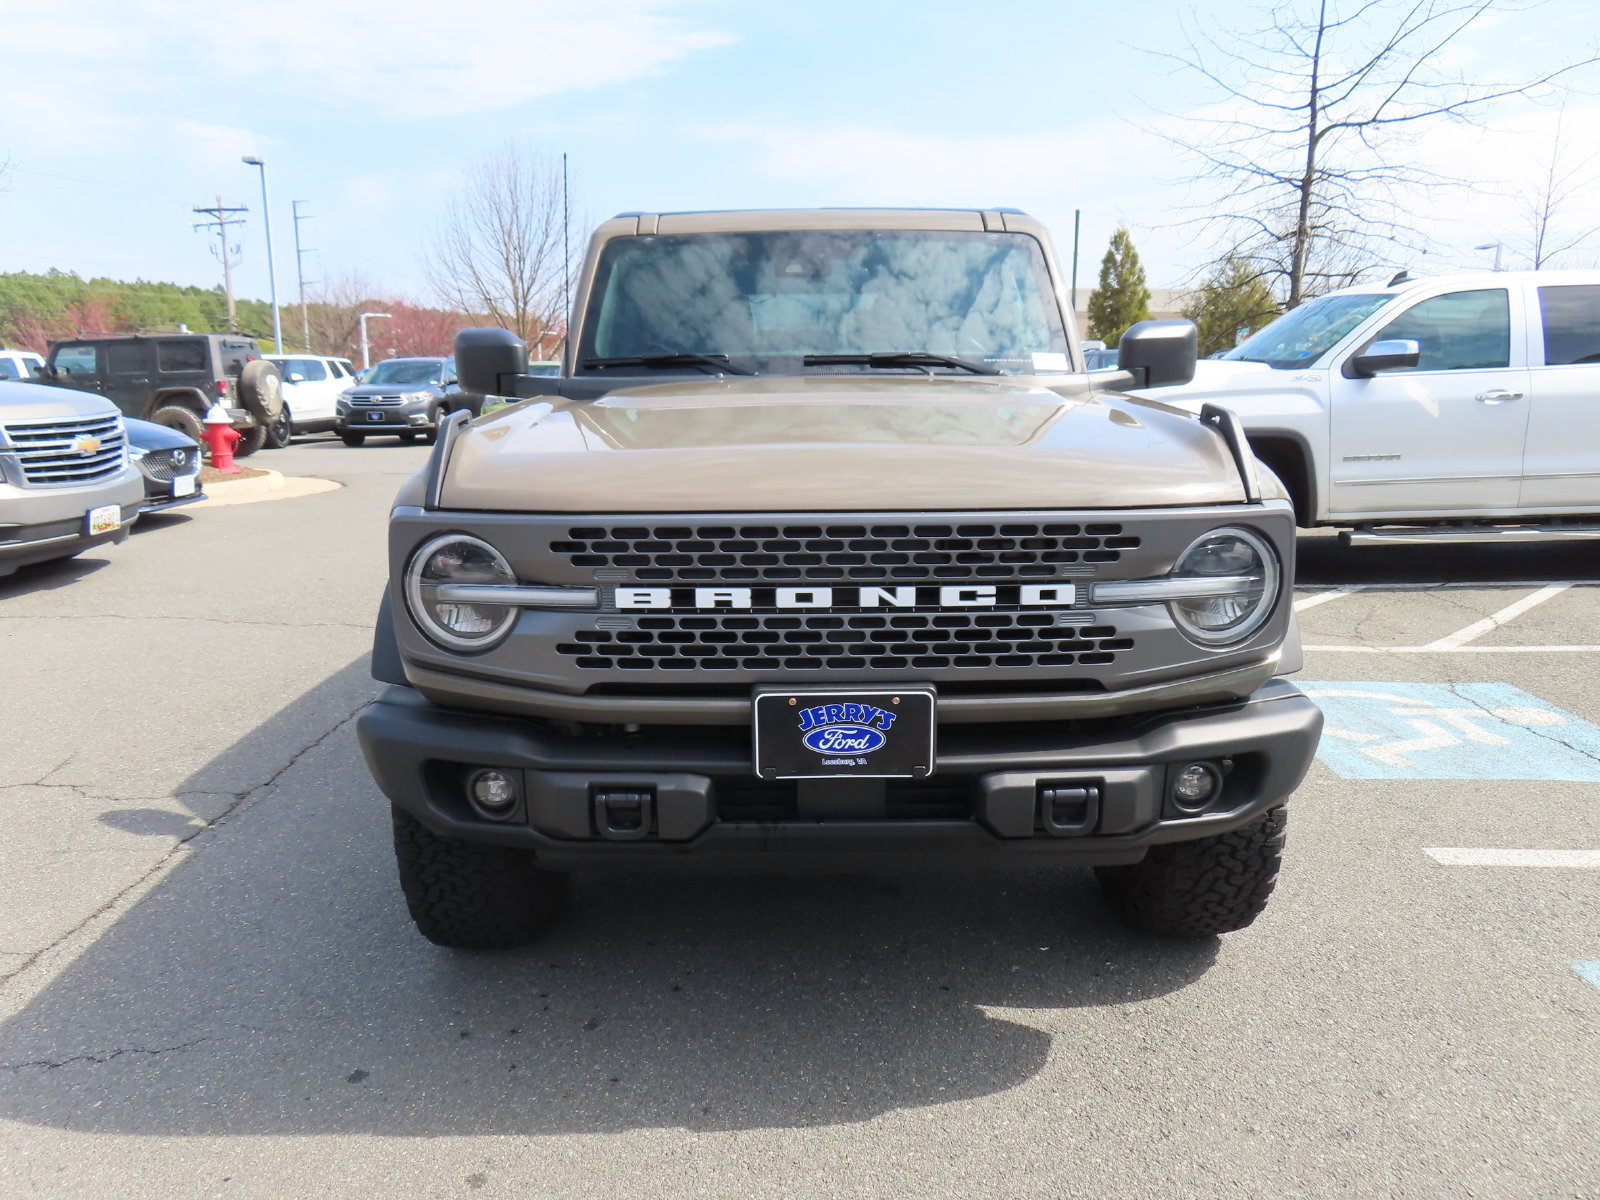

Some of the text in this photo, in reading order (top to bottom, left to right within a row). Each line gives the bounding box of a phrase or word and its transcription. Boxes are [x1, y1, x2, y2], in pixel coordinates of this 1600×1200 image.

[614, 585, 1077, 610] BRONCO
[798, 703, 897, 731] JERRY'S
[818, 728, 870, 750] Ford
